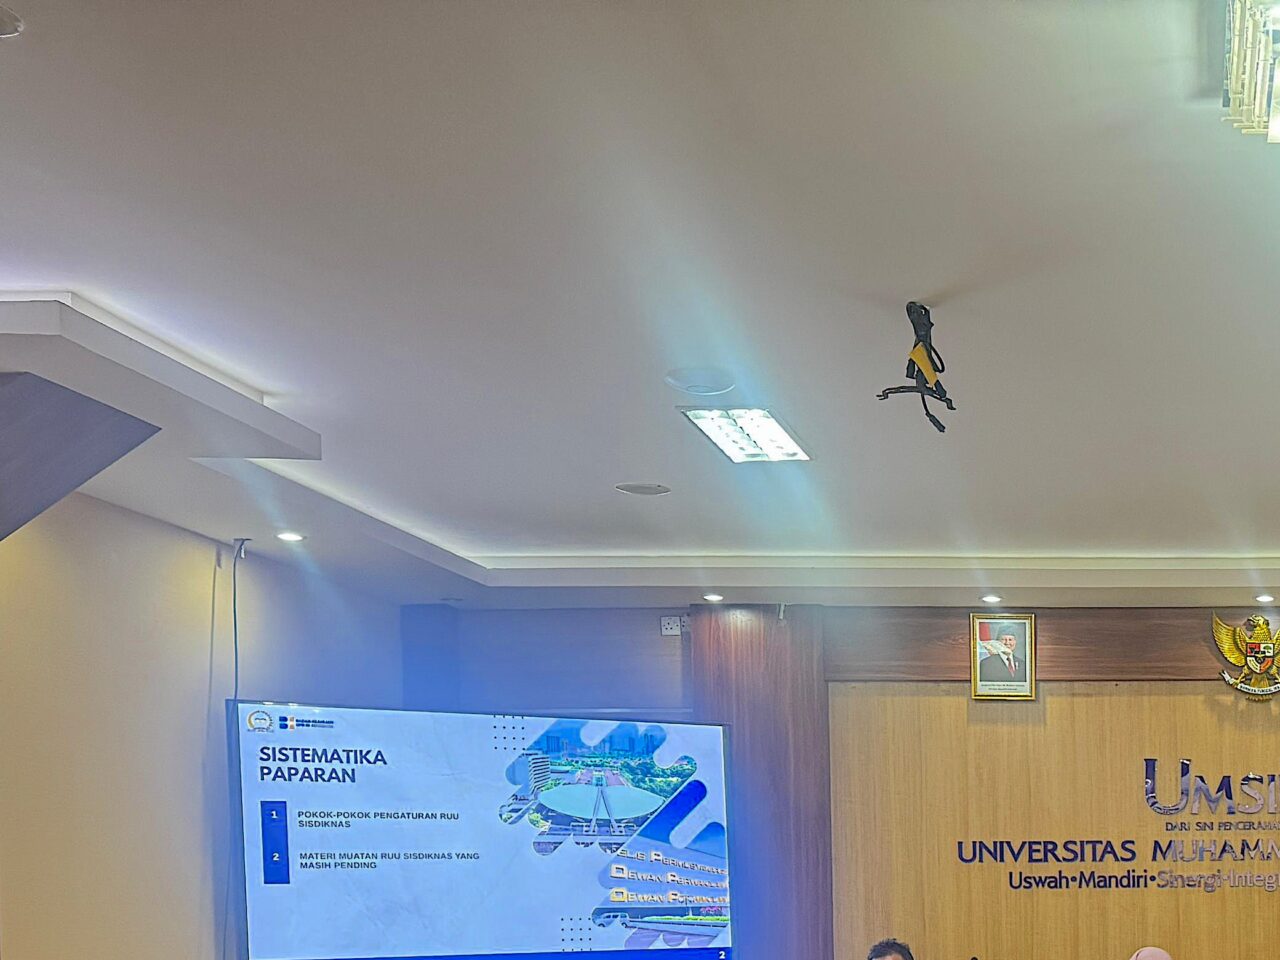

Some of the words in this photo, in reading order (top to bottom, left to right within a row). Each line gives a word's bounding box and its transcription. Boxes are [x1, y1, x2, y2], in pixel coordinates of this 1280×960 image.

[259, 746, 388, 765] SISTEMATIKA
[259, 765, 357, 783] PAPARAN
[270, 810, 279, 819] 1
[297, 810, 371, 820] POKOK-POKOK
[373, 812, 438, 821] PENGATURAN
[439, 812, 460, 820] RUU
[298, 819, 351, 828] SISDIKNAS
[1165, 821, 1190, 831] DARI
[1195, 821, 1214, 831] SINI
[272, 852, 280, 861] 2
[299, 852, 337, 860] MATERI
[338, 852, 378, 860] MUATAN
[380, 852, 401, 860] RUU
[403, 852, 452, 860] SISDIKNAS
[455, 852, 480, 860] YANG
[957, 839, 1136, 864] UNIVERSITAS
[299, 861, 332, 870] MASIH
[333, 861, 377, 870] PENDING
[718, 950, 726, 960] 2
